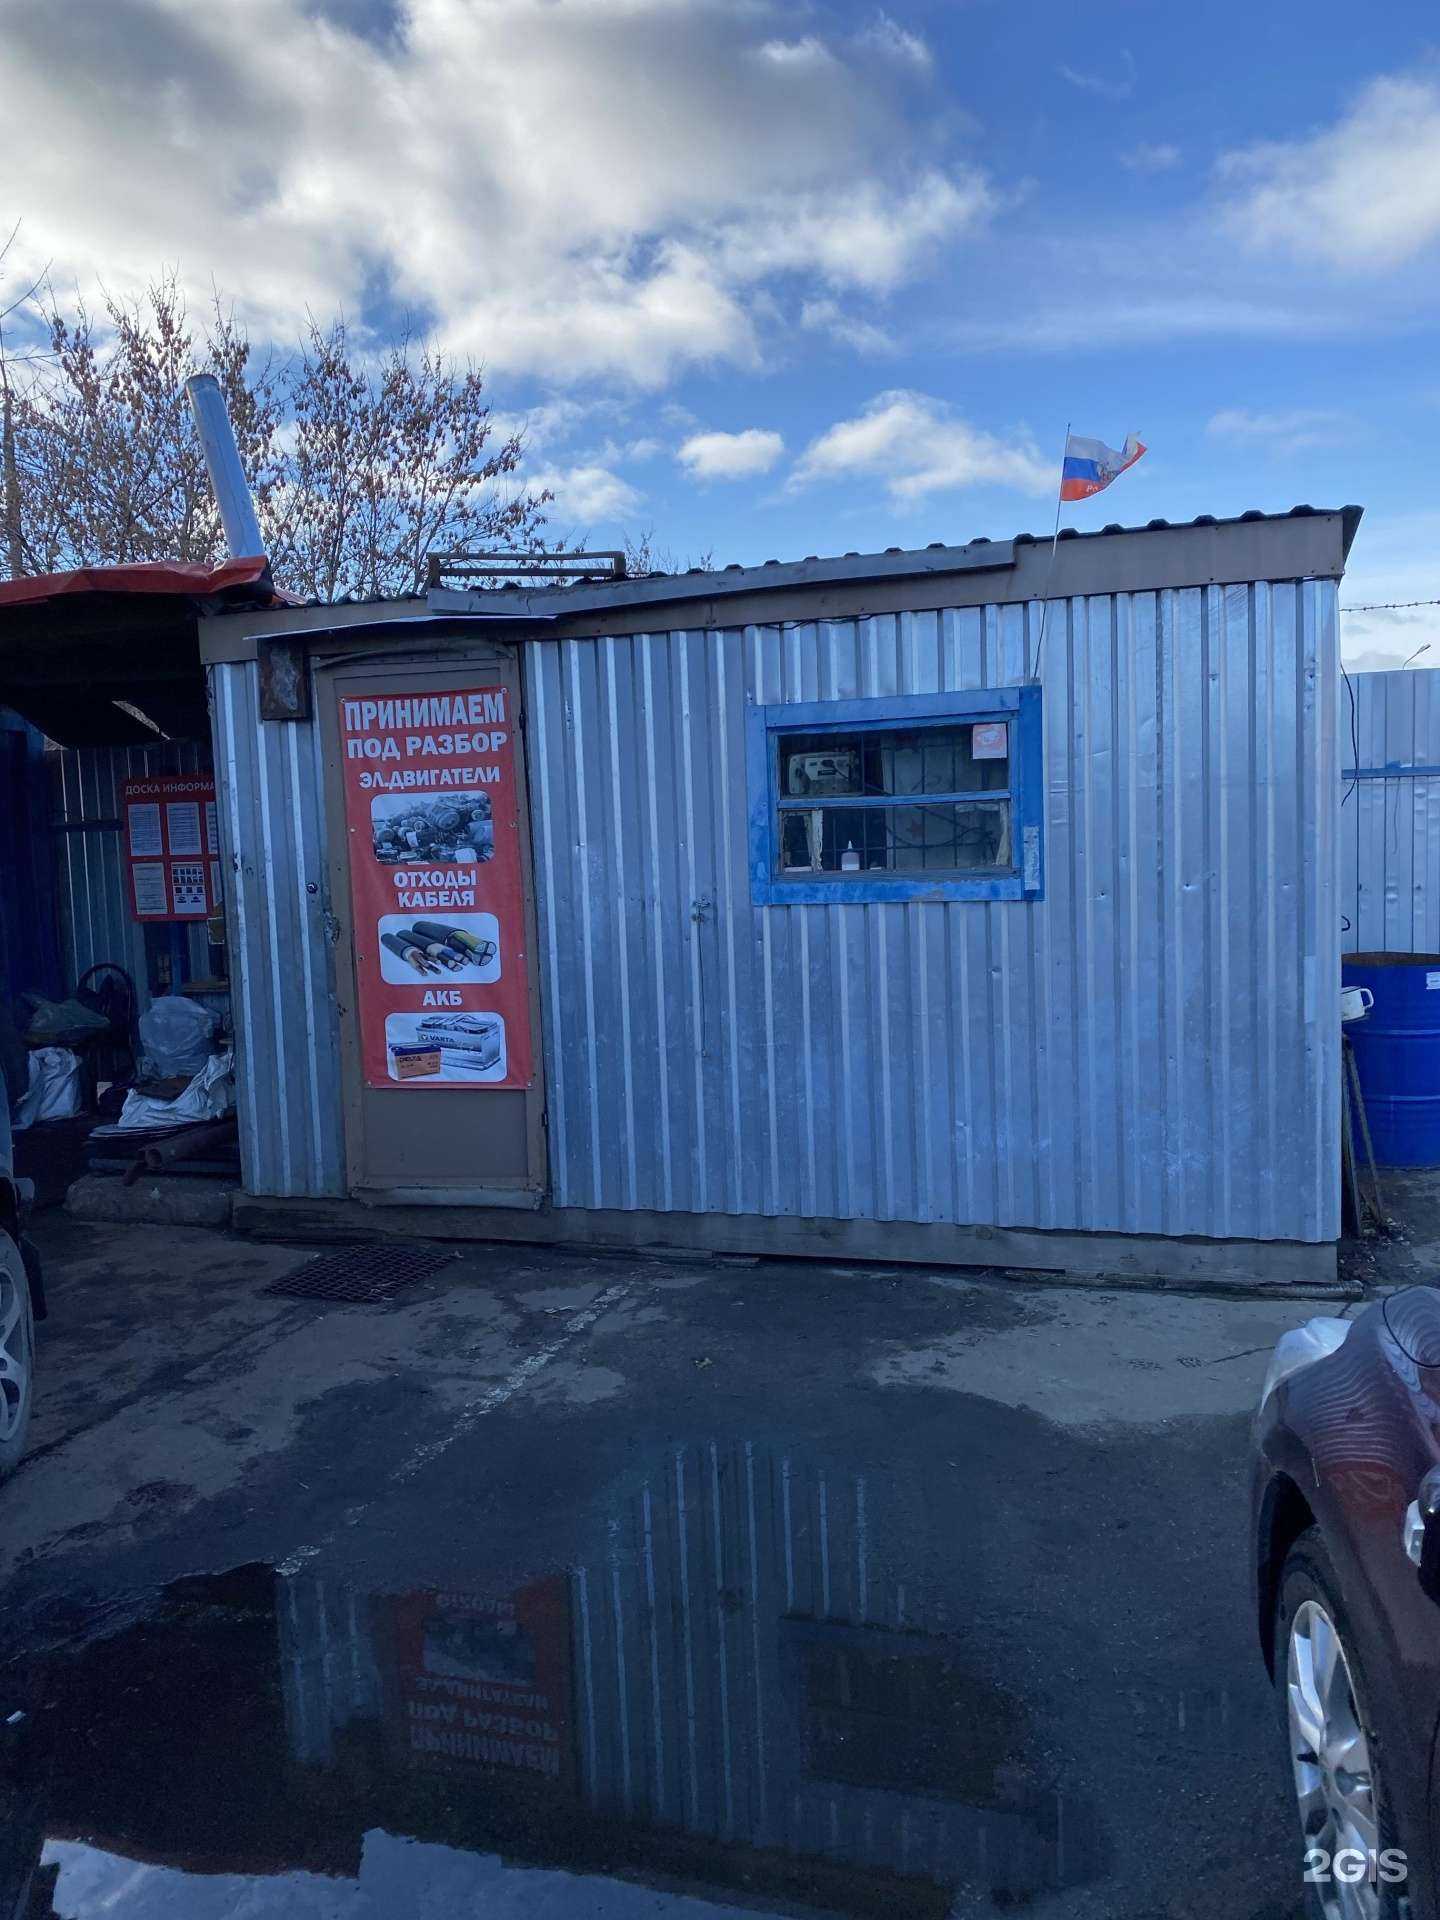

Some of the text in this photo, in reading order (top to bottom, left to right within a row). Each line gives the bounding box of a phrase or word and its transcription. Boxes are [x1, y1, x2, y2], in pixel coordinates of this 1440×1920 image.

[344, 693, 505, 731] ПРИНИМАЕМ
[347, 731, 507, 760] ПОД РАЗБОР
[359, 766, 500, 789] ЭЛ.ДВИГАТЕЛИ
[126, 784, 160, 795] ДОСКА
[394, 870, 477, 889] ОТХОДЫ
[397, 891, 475, 908] КАБЕЛЯ
[422, 990, 463, 1006] АКБ
[430, 1035, 455, 1043] VARTA
